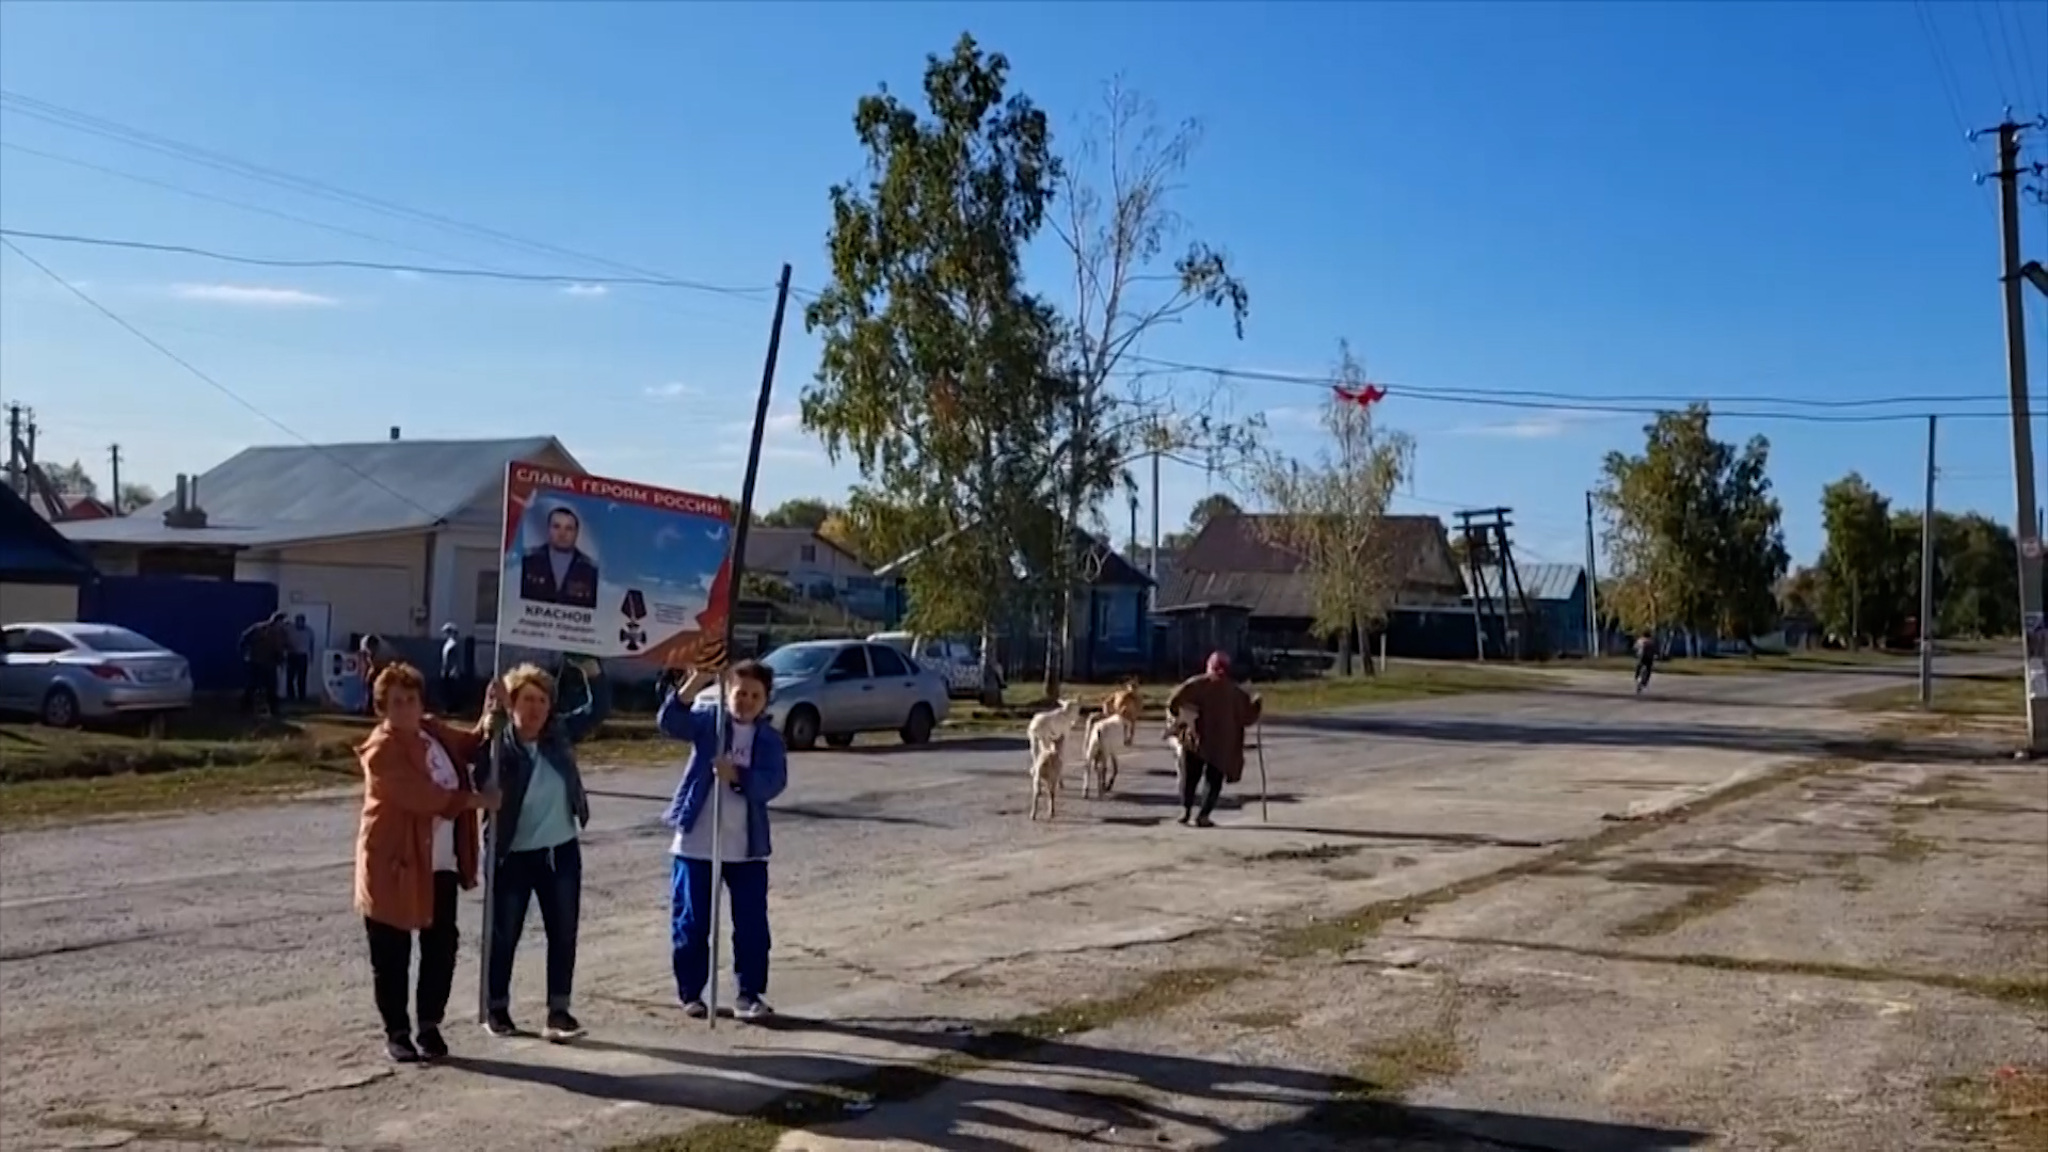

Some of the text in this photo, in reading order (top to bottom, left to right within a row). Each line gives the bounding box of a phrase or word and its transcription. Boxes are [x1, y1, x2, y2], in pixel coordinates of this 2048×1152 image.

[516, 468, 722, 515] СЛАВА ГЕРОЯМ РОССИИ!
[525, 605, 591, 623] КРАСНОВ
